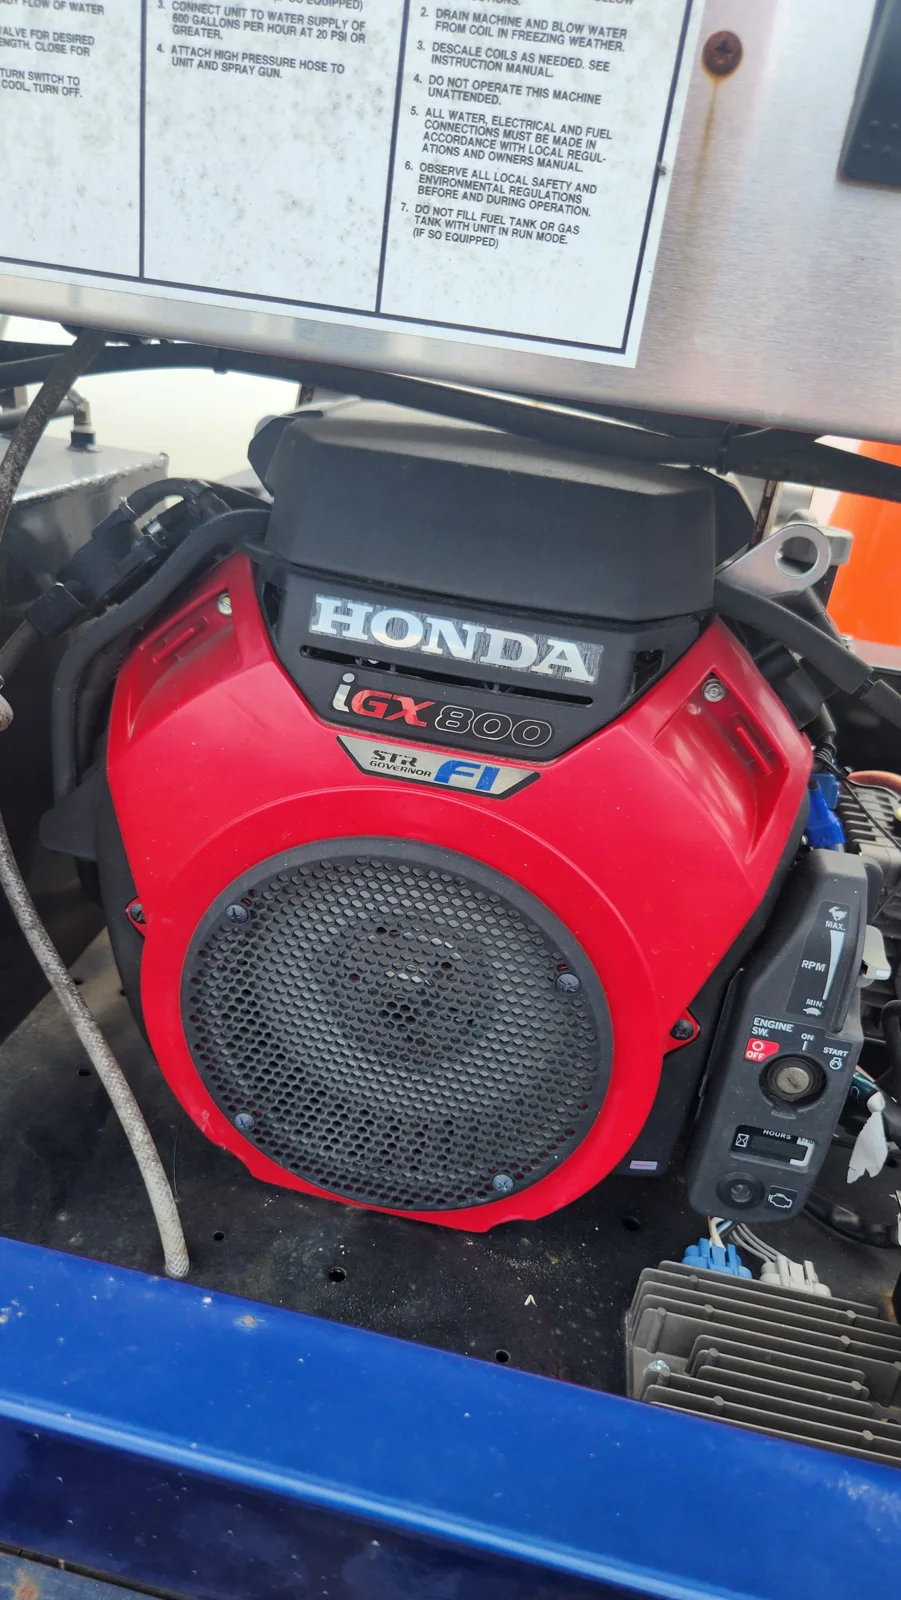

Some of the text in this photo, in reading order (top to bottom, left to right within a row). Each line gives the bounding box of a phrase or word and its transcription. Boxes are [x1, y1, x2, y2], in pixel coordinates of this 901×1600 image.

[54, 0, 66, 10] OF
[69, 2, 104, 15] WATER
[158, 0, 366, 32] 3. CONNECT UNIT TO WATER SUPPLY OF
[172, 13, 366, 44] 600 GALLONS PER HOUR AT 20 PSI OR
[172, 24, 223, 40] GREATER.
[420, 7, 627, 39] 2. DRAIN MACHINE AND BLOW WATER
[30, 29, 50, 40] FOR
[52, 32, 94, 46] DESIRED
[435, 20, 624, 52] FROM COIL IN FREEZING WEATHER.
[35, 42, 67, 54] CLOSE
[70, 46, 90, 56] FOR
[157, 44, 345, 74] 4. ATTACH HIGH PRESSURE HOSE TO
[417, 40, 610, 72] 3. DESCALE COILS AS NEEDED. SEE
[0, 68, 80, 86] TURN SWITCH TO
[172, 56, 282, 79] UNIT AND SPRAY GUN.
[431, 54, 554, 78] INSTRUCTION MANUAL.
[33, 83, 58, 95] TURN
[62, 86, 82, 98] OFF.
[414, 75, 602, 105] 4. DO NOT OPERATE THIS MACHINE
[428, 87, 501, 106] UNATTENDED.
[410, 106, 612, 140] 5. ALL WATER, ELECTRICAL AND FUEL
[424, 120, 596, 150] CONNECTIONS MUST BE MADE IN
[422, 143, 584, 173] ATIONS AND OWNERS MANUAL.
[423, 131, 606, 163] ACCORDANCE WITH LOCAL REGUL-
[405, 160, 597, 194] 6. OBSERVE ALL LOCAL SAFETY AND
[418, 174, 582, 204] ENVIRONMENTAL REGULATIONS
[418, 185, 591, 218] BEFORE AND DURING OPERATION.
[401, 202, 580, 236] 7. DO NOT FILL FUEL TANK OR GAS
[415, 215, 568, 245] TANK WITH UNIT IN RUN MODE.
[413, 228, 498, 249] (IF SO EQUIPPED)
[311, 594, 597, 682] HONDA
[370, 760, 432, 778] GOVERNOR
[371, 750, 500, 791] STR FI
[826, 920, 846, 930] MAX.
[801, 960, 826, 972] RPM
[806, 999, 824, 1008] MIN.
[752, 1026, 768, 1037] SW.
[753, 1018, 794, 1032] ENGINE
[801, 1033, 814, 1041] ON
[746, 1050, 764, 1060] OFF
[823, 1046, 848, 1058] START
[763, 1129, 791, 1140] HOURS
